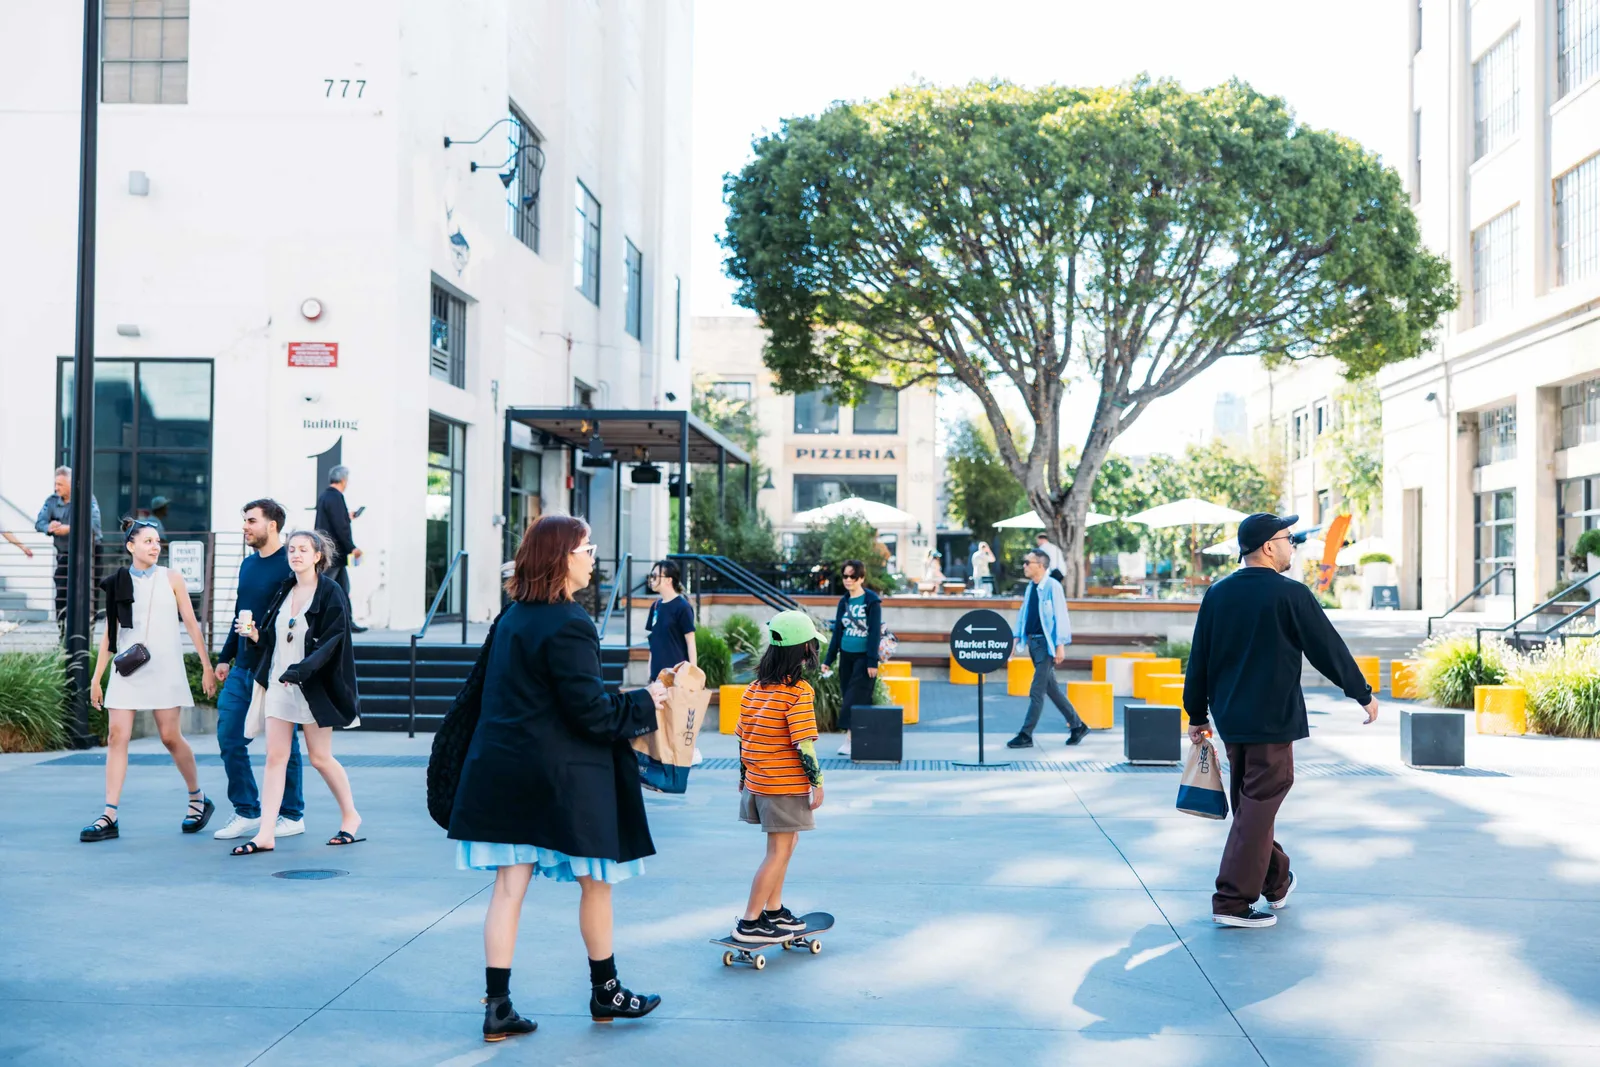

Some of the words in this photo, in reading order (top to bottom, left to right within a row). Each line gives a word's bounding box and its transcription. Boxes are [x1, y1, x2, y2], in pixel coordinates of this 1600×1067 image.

[324, 79, 366, 98] 777
[303, 419, 358, 431] Building
[796, 448, 896, 460] PIZZERIA
[181, 567, 192, 576] NO
[954, 639, 987, 649] Market
[987, 639, 1008, 649] Row
[958, 650, 1003, 660] Deliveries
